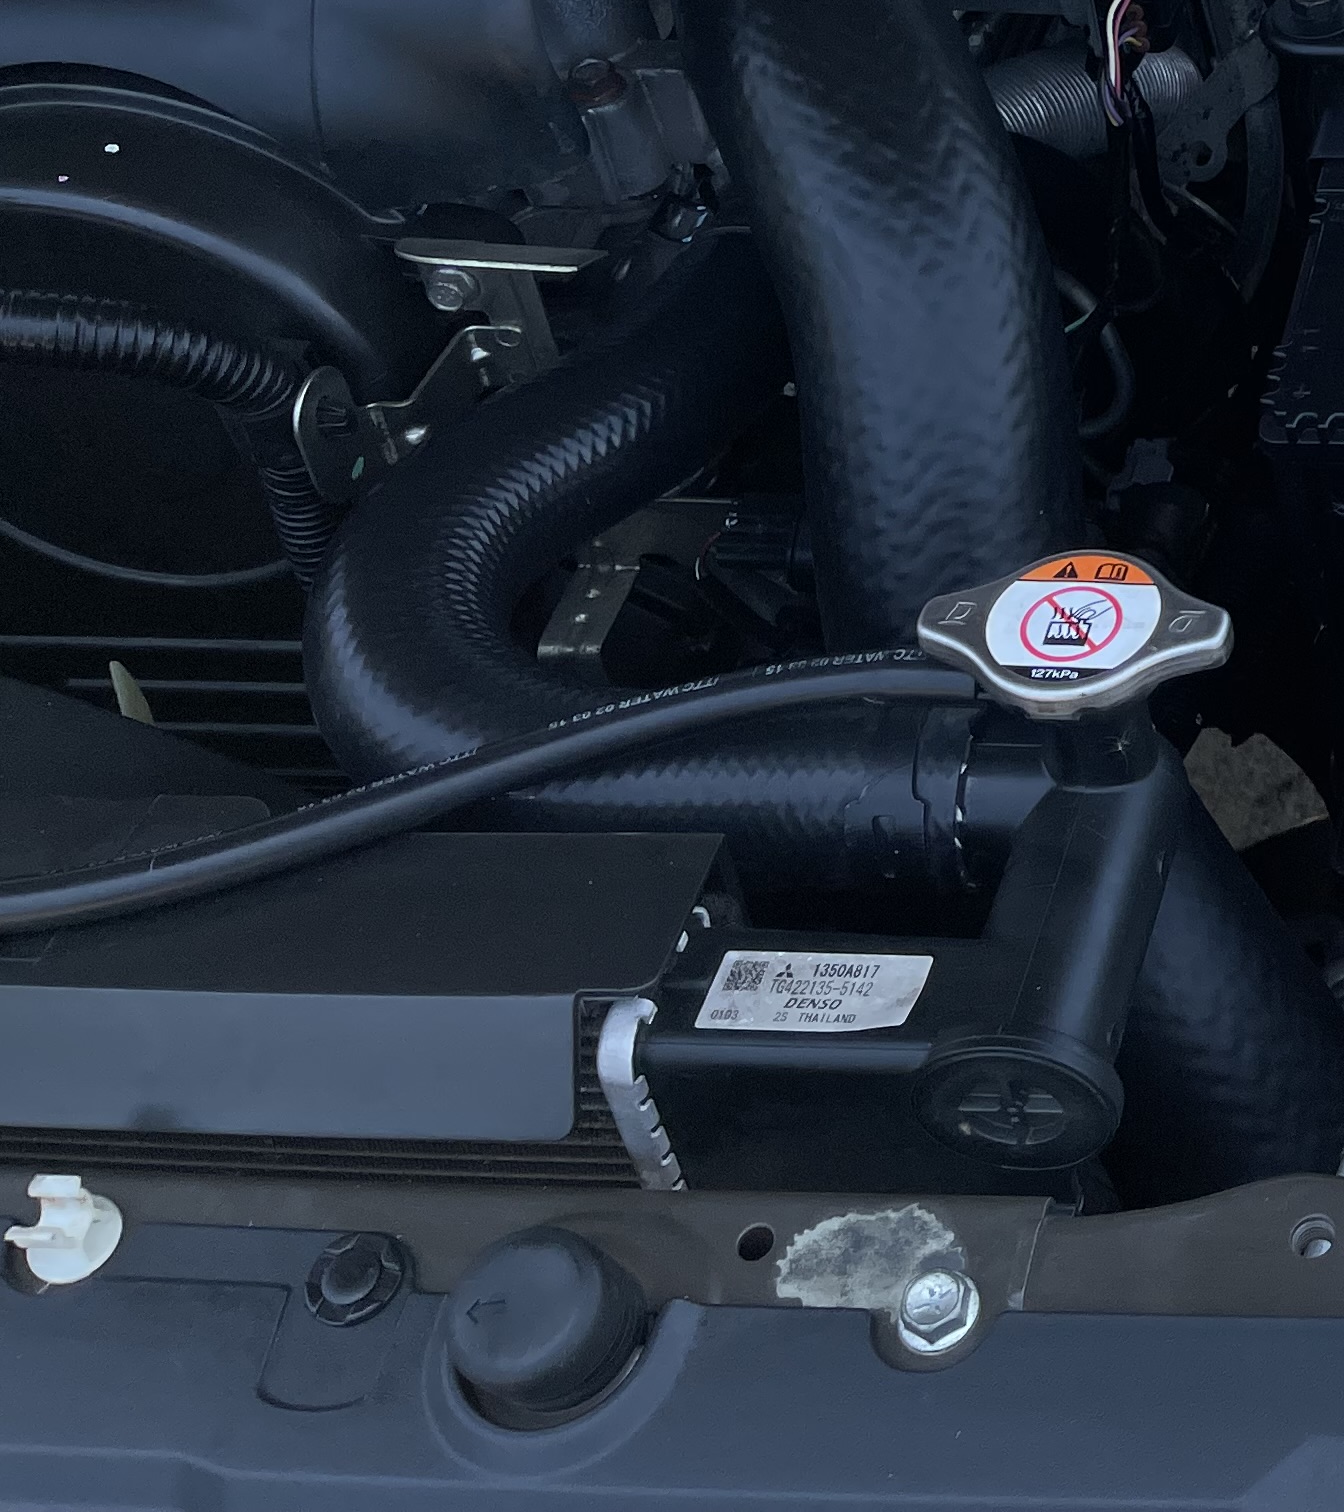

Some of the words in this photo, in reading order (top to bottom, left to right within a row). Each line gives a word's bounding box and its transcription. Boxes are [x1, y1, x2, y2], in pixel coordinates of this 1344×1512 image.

[1030, 668, 1080, 681] 127kPa
[618, 685, 680, 710] WATER
[594, 702, 616, 716] 02
[572, 710, 592, 723] 03
[812, 964, 881, 979] 1350A817
[769, 978, 874, 997] TG422135-5142
[783, 998, 842, 1010] DENSO
[798, 1012, 857, 1024] THAILAND
